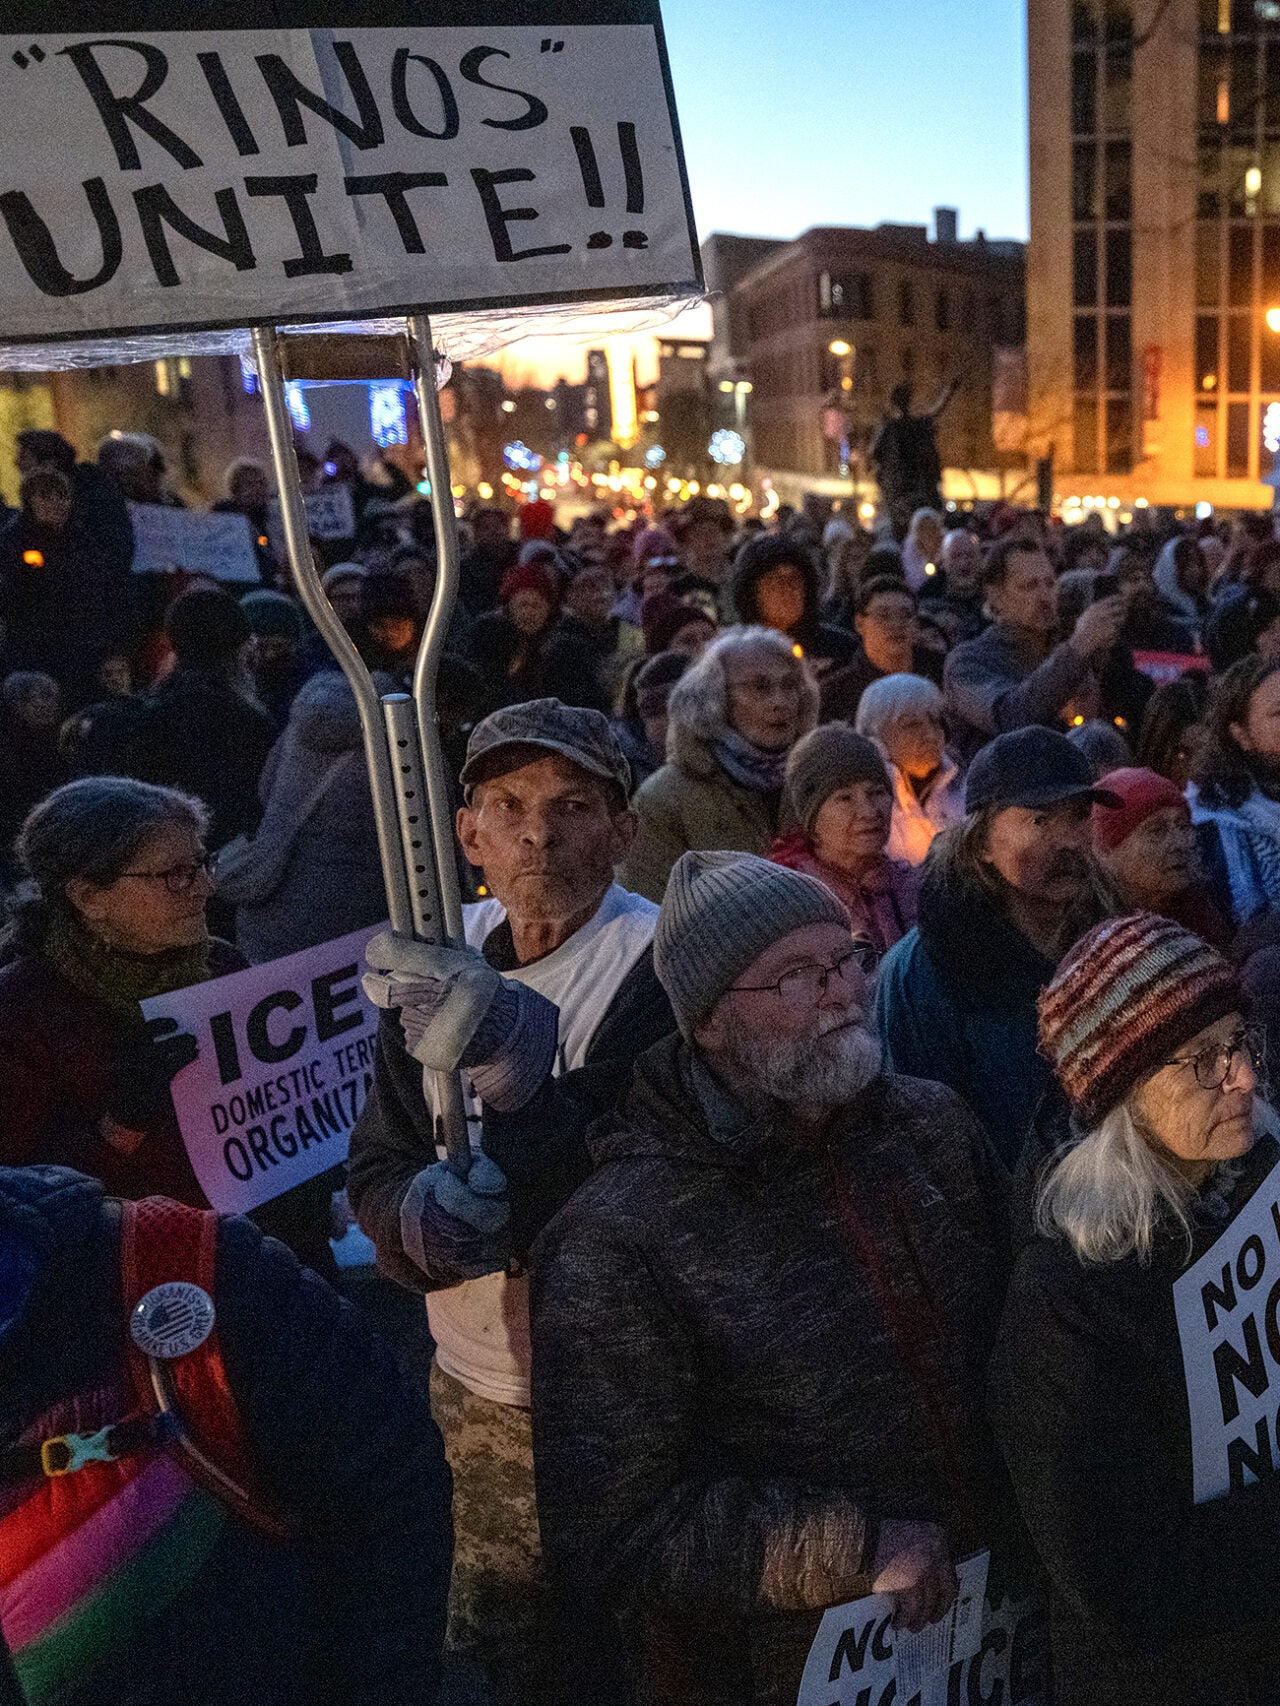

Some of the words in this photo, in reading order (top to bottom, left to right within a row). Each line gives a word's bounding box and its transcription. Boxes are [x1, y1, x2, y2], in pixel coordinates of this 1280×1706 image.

[0, 121, 649, 297] UNITE!!
[209, 963, 364, 1086] ICE
[211, 1060, 326, 1135] DOMESTIC
[1200, 1234, 1266, 1333] NO
